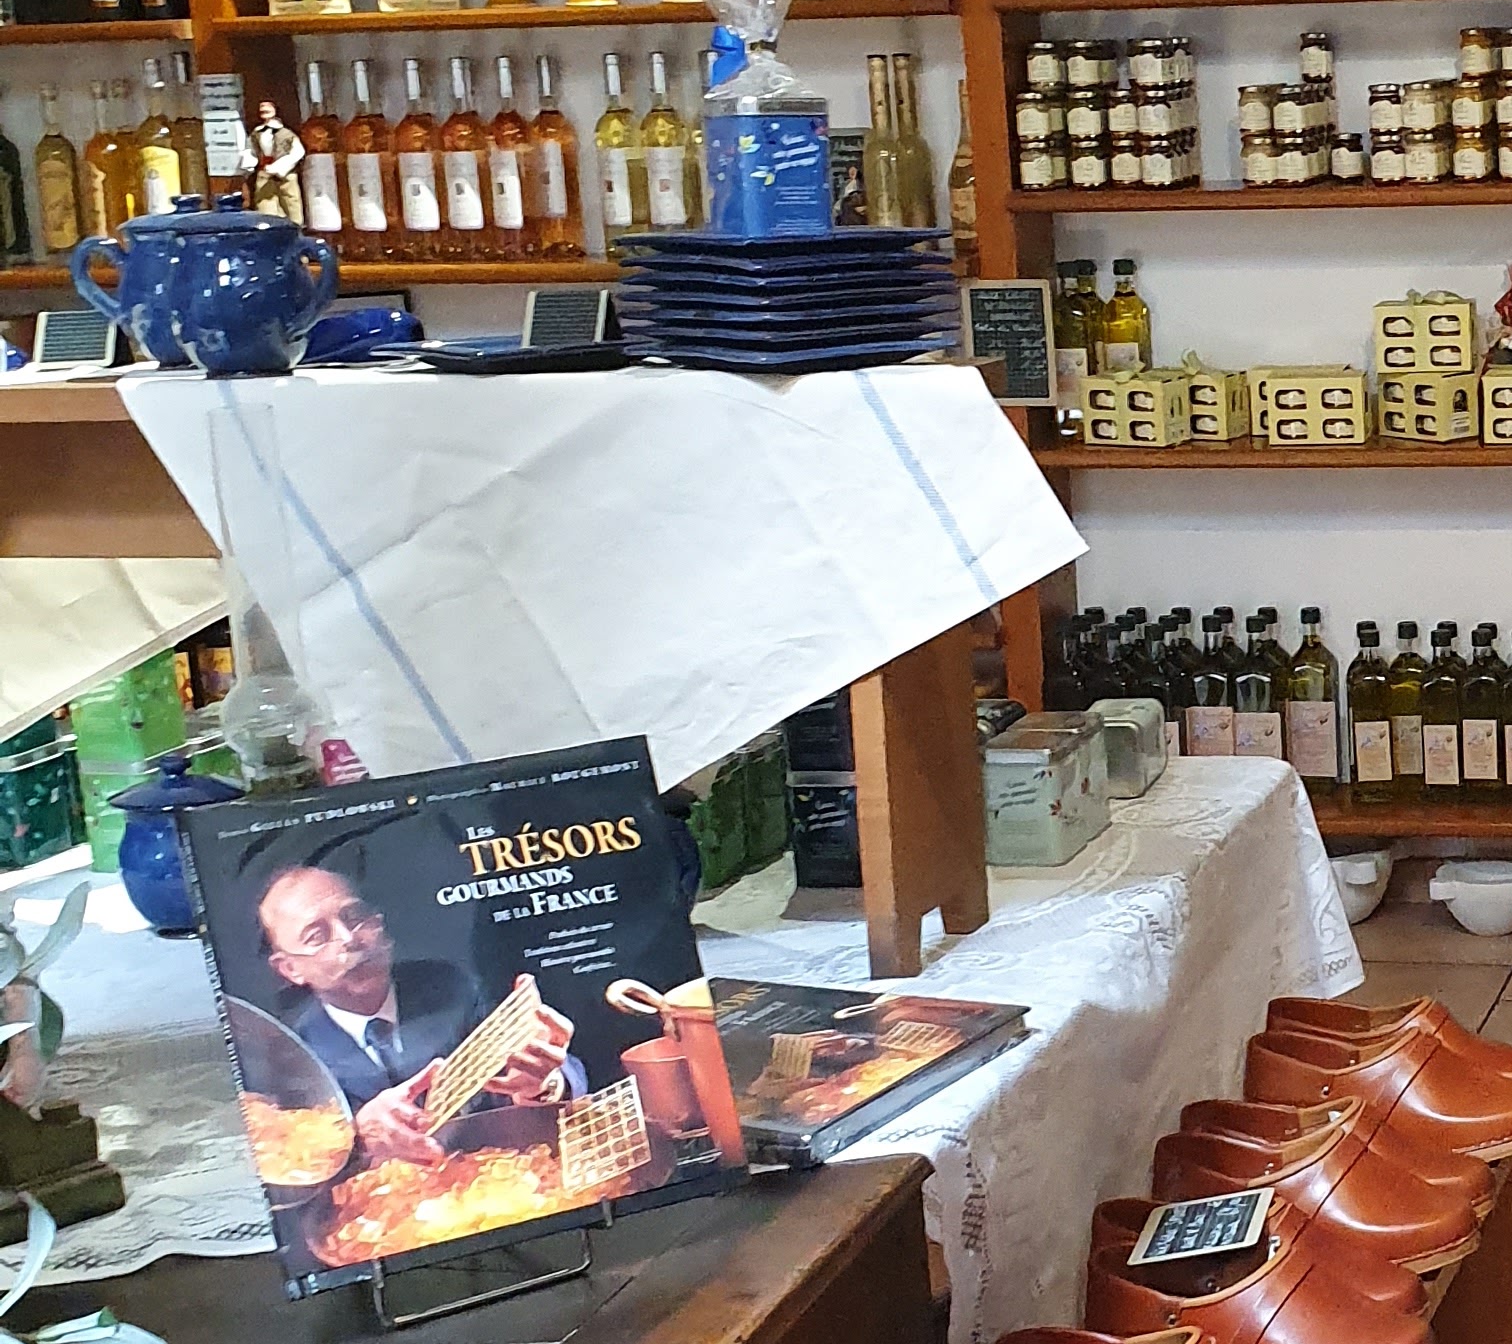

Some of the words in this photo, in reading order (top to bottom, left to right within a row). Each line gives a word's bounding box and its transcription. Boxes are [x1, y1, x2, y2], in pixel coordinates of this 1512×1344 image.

[459, 817, 642, 876] TRÉSORS
[436, 865, 574, 906] GOURMANDS
[530, 883, 618, 916] FRANCE
